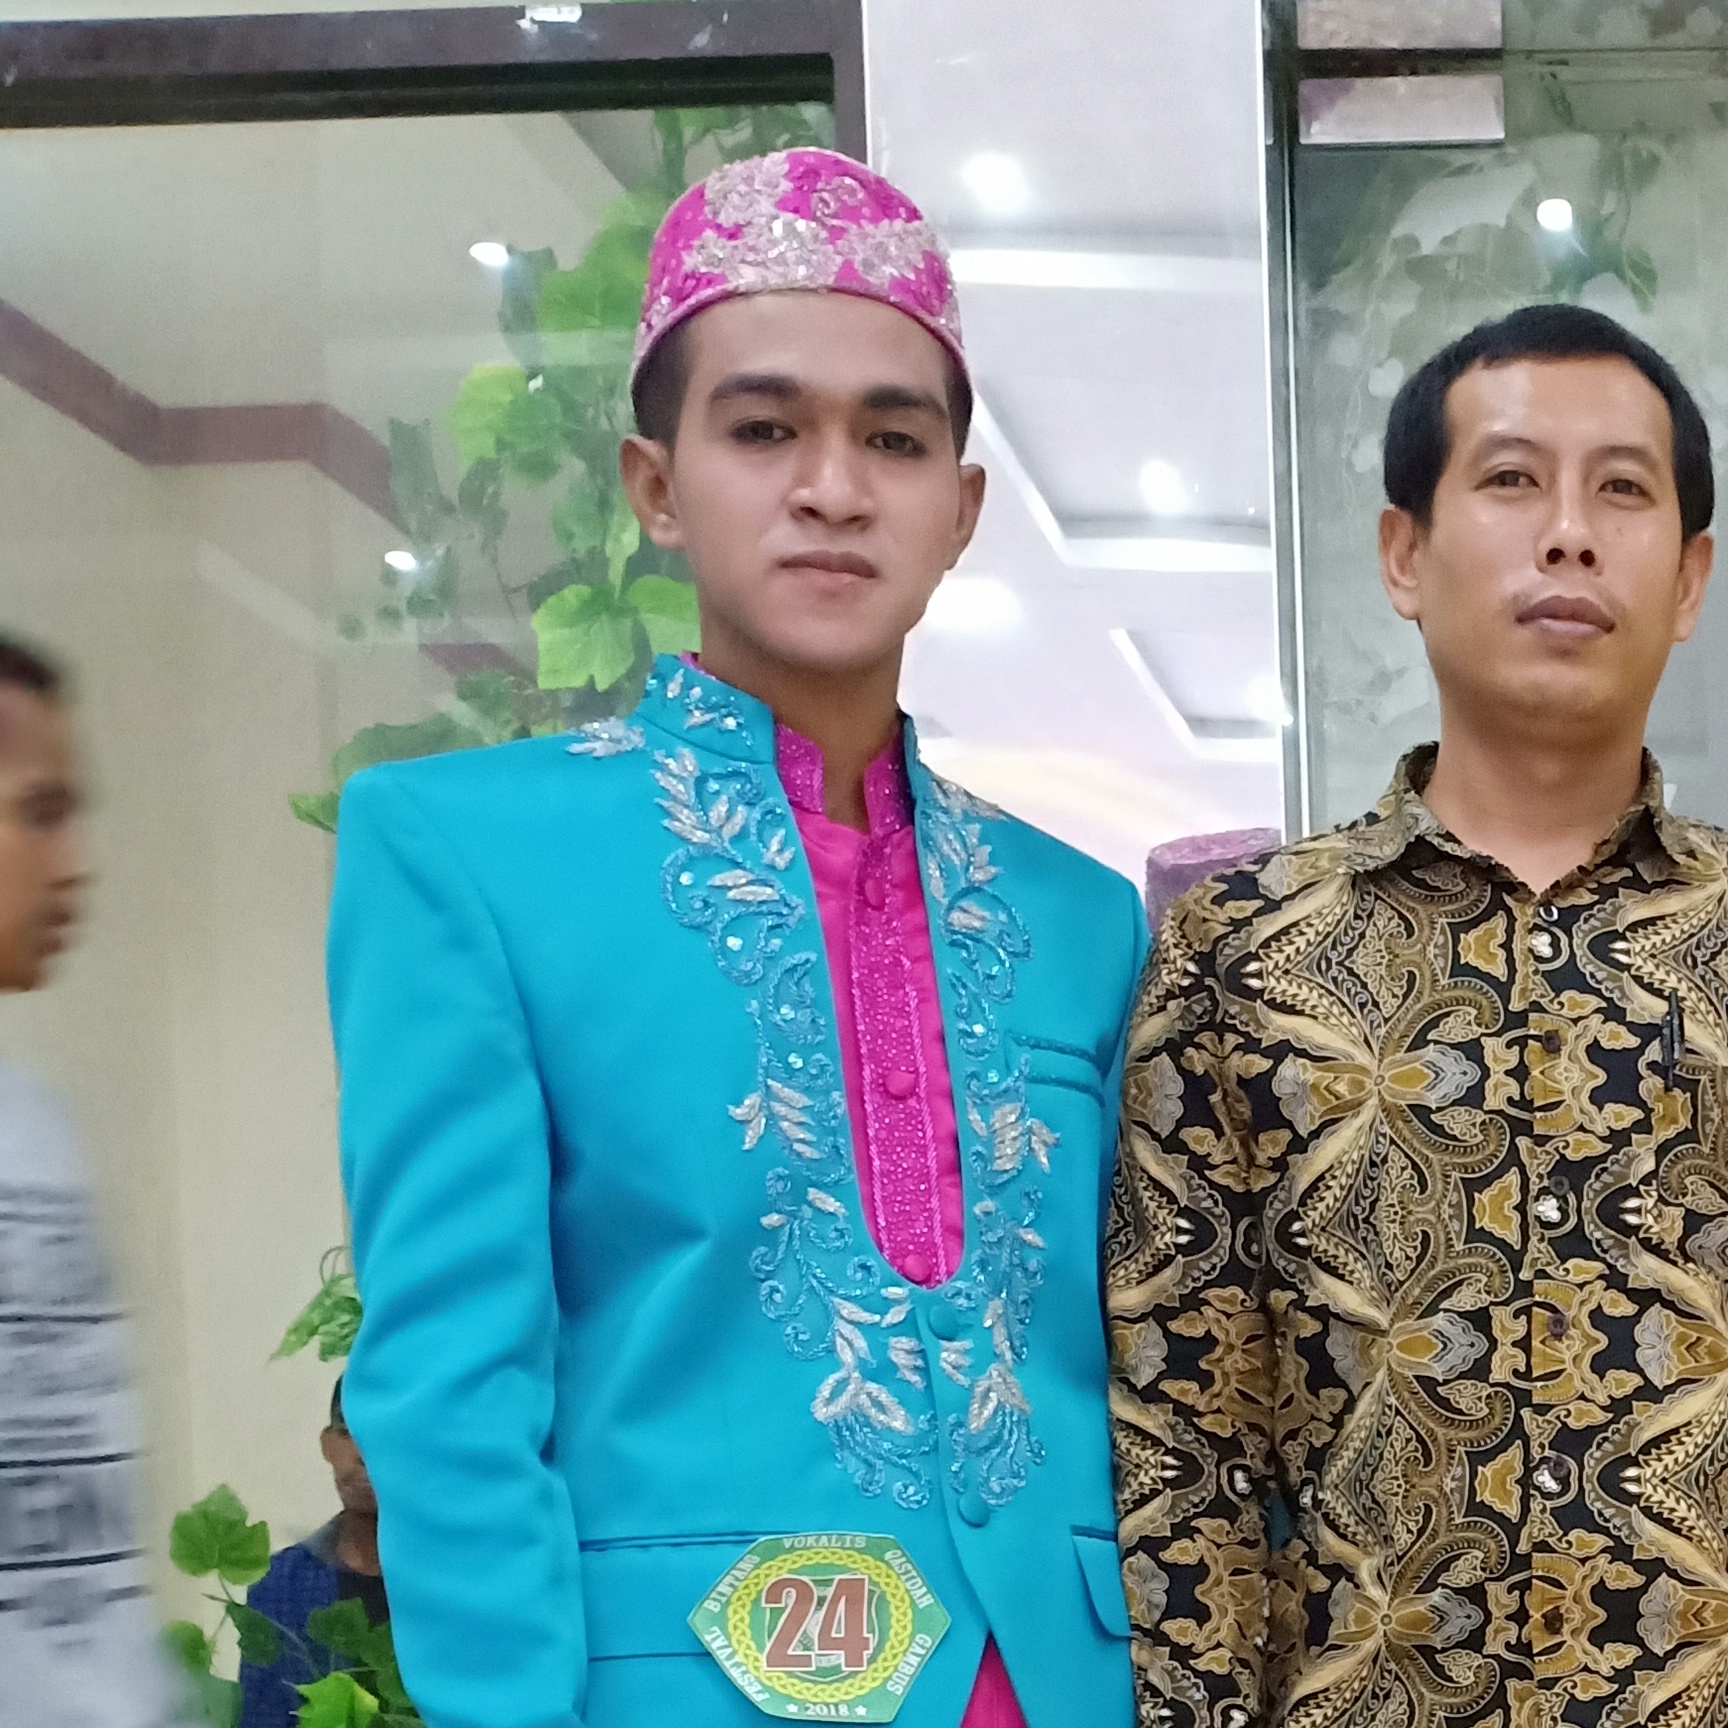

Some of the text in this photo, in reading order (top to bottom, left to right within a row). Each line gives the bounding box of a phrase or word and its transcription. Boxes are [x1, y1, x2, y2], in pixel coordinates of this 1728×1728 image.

[782, 1535, 867, 1549] VOKALIS
[703, 1554, 761, 1613] BINTANG
[884, 1549, 935, 1609] QASIDAH
[761, 1574, 873, 1672] 24
[704, 1626, 771, 1702] FESTIVAL
[886, 1633, 933, 1696] GAMBUS
[805, 1703, 850, 1717] 2018
